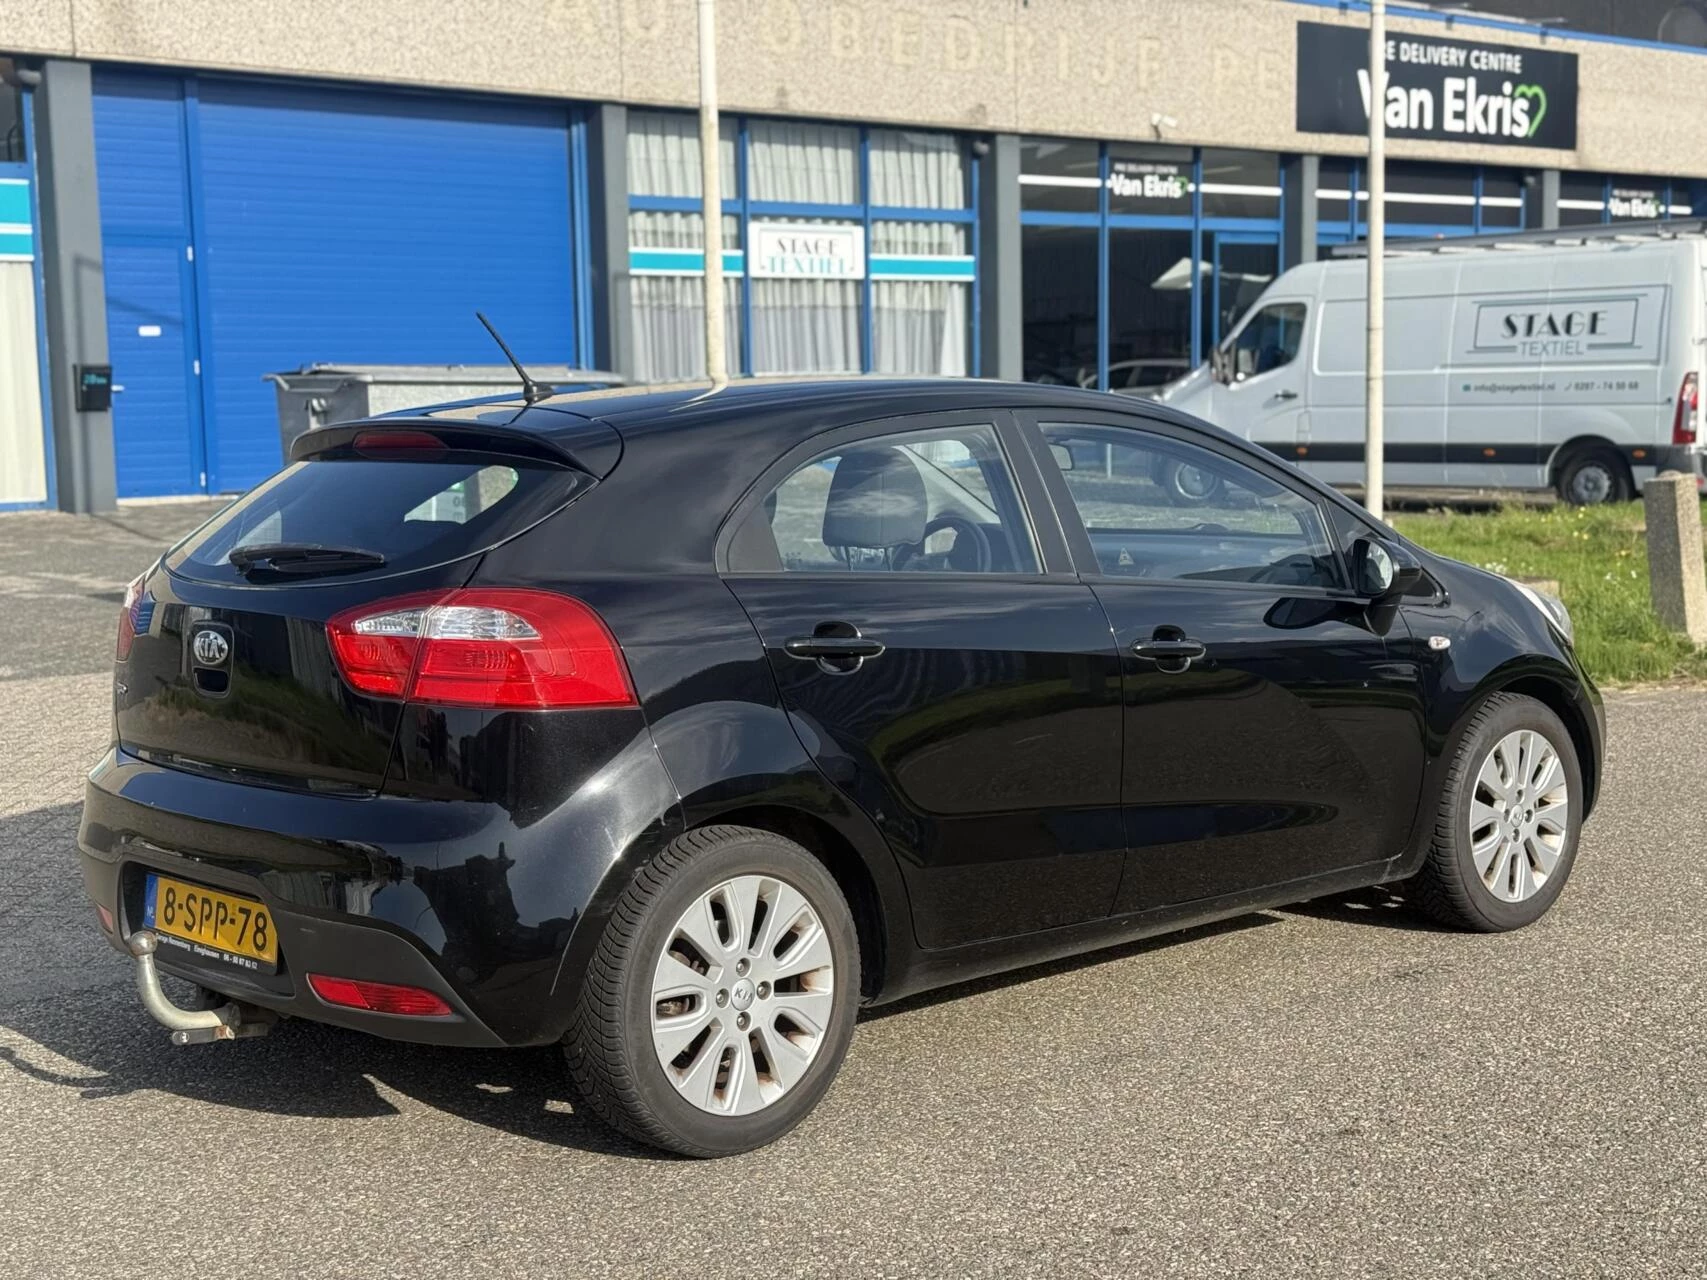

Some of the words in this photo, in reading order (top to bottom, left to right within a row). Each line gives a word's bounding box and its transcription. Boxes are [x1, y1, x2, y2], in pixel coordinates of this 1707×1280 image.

[1400, 41, 1467, 68] DELIVERY
[1470, 49, 1522, 74] CENTRE
[1444, 76, 1530, 138] Ekris
[1111, 173, 1142, 196] Van
[1144, 175, 1182, 198] Ekris
[777, 238, 840, 255] STAGE
[767, 256, 845, 275] TEXTIEL
[1501, 310, 1608, 339] STAGE
[1520, 340, 1584, 357] TEXTIEL
[195, 636, 221, 659] KIA
[164, 887, 268, 951] 8-SPP-78
[734, 987, 753, 1003] KIA
